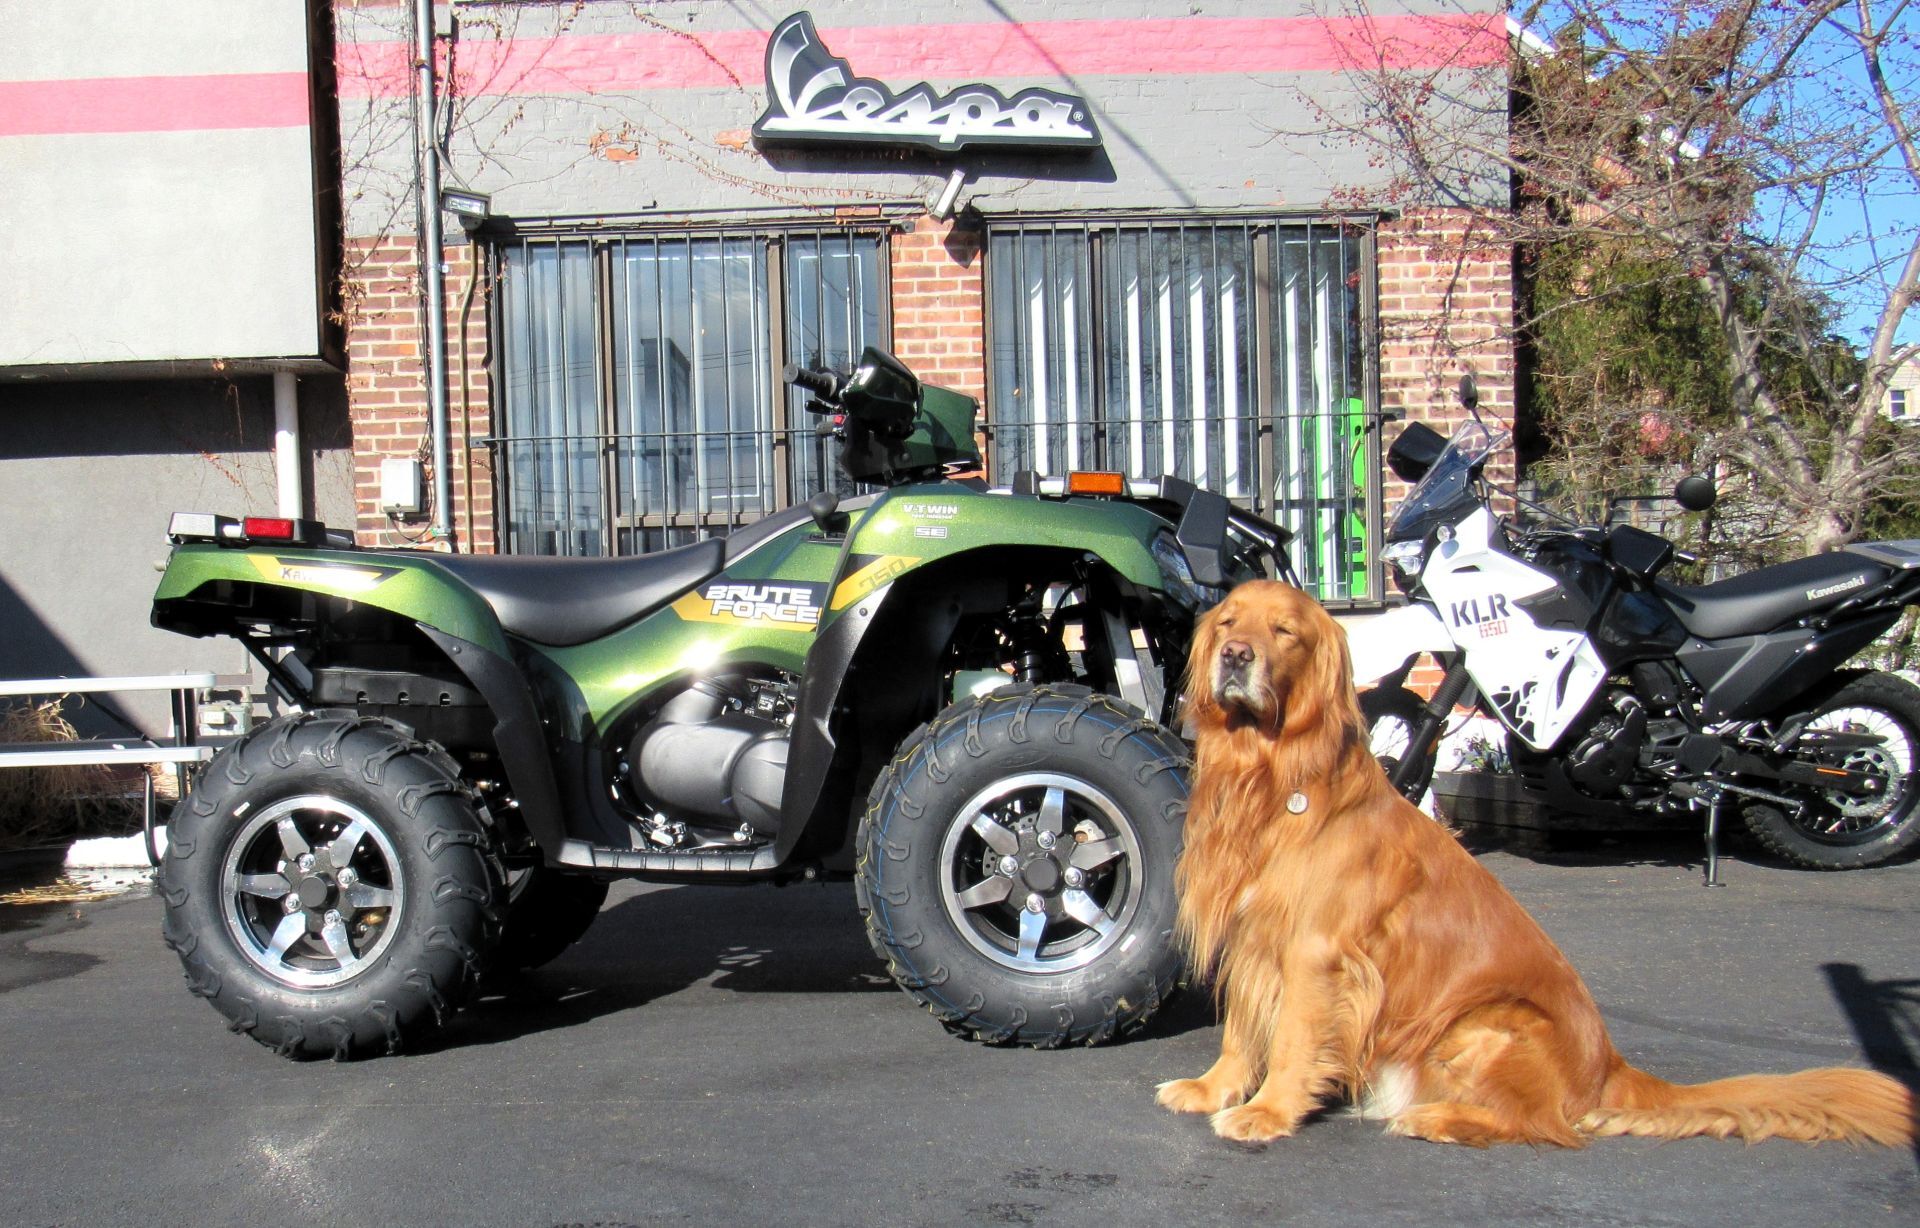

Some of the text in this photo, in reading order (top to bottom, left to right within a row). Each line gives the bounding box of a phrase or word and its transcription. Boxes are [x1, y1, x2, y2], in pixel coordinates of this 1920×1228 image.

[761, 19, 1093, 144] Vespa
[903, 504, 958, 514] V-TWIN
[916, 527, 946, 537] SE
[859, 559, 906, 588] 750
[706, 585, 812, 605] BRUTE
[1806, 575, 1865, 600] Kawasaki
[711, 600, 818, 623] FORCE
[1451, 593, 1510, 627] KLR
[1480, 620, 1508, 638] 650
